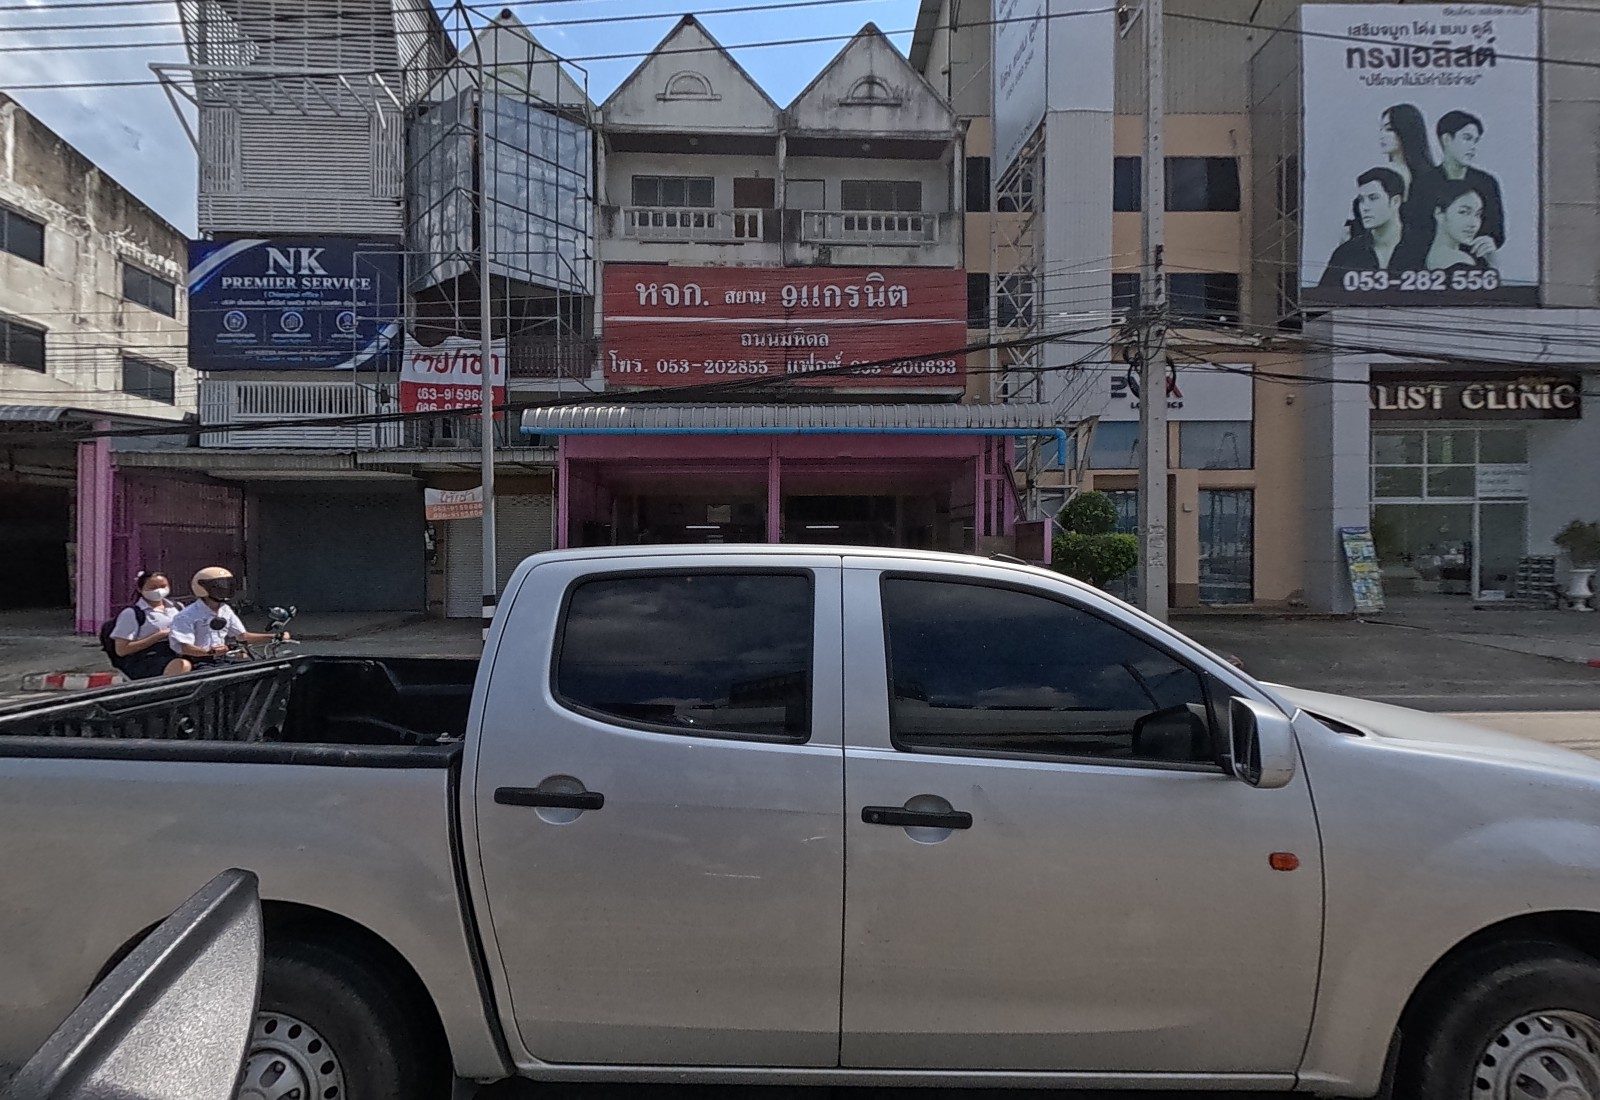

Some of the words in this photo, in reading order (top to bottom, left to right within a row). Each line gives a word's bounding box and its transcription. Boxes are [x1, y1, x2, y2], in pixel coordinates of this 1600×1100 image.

[265, 247, 328, 275] NK
[221, 276, 297, 290] PREMIER
[300, 276, 371, 291] SERVICE
[1343, 269, 1447, 291] 053-282
[1452, 269, 1499, 291] 556
[635, 282, 710, 307] หจก.
[724, 289, 767, 304] สยาม
[740, 327, 829, 347] ถนนมหิดล
[608, 349, 648, 373] โทร.
[656, 358, 768, 374] 053-202855
[1461, 384, 1575, 410] CLINIC
